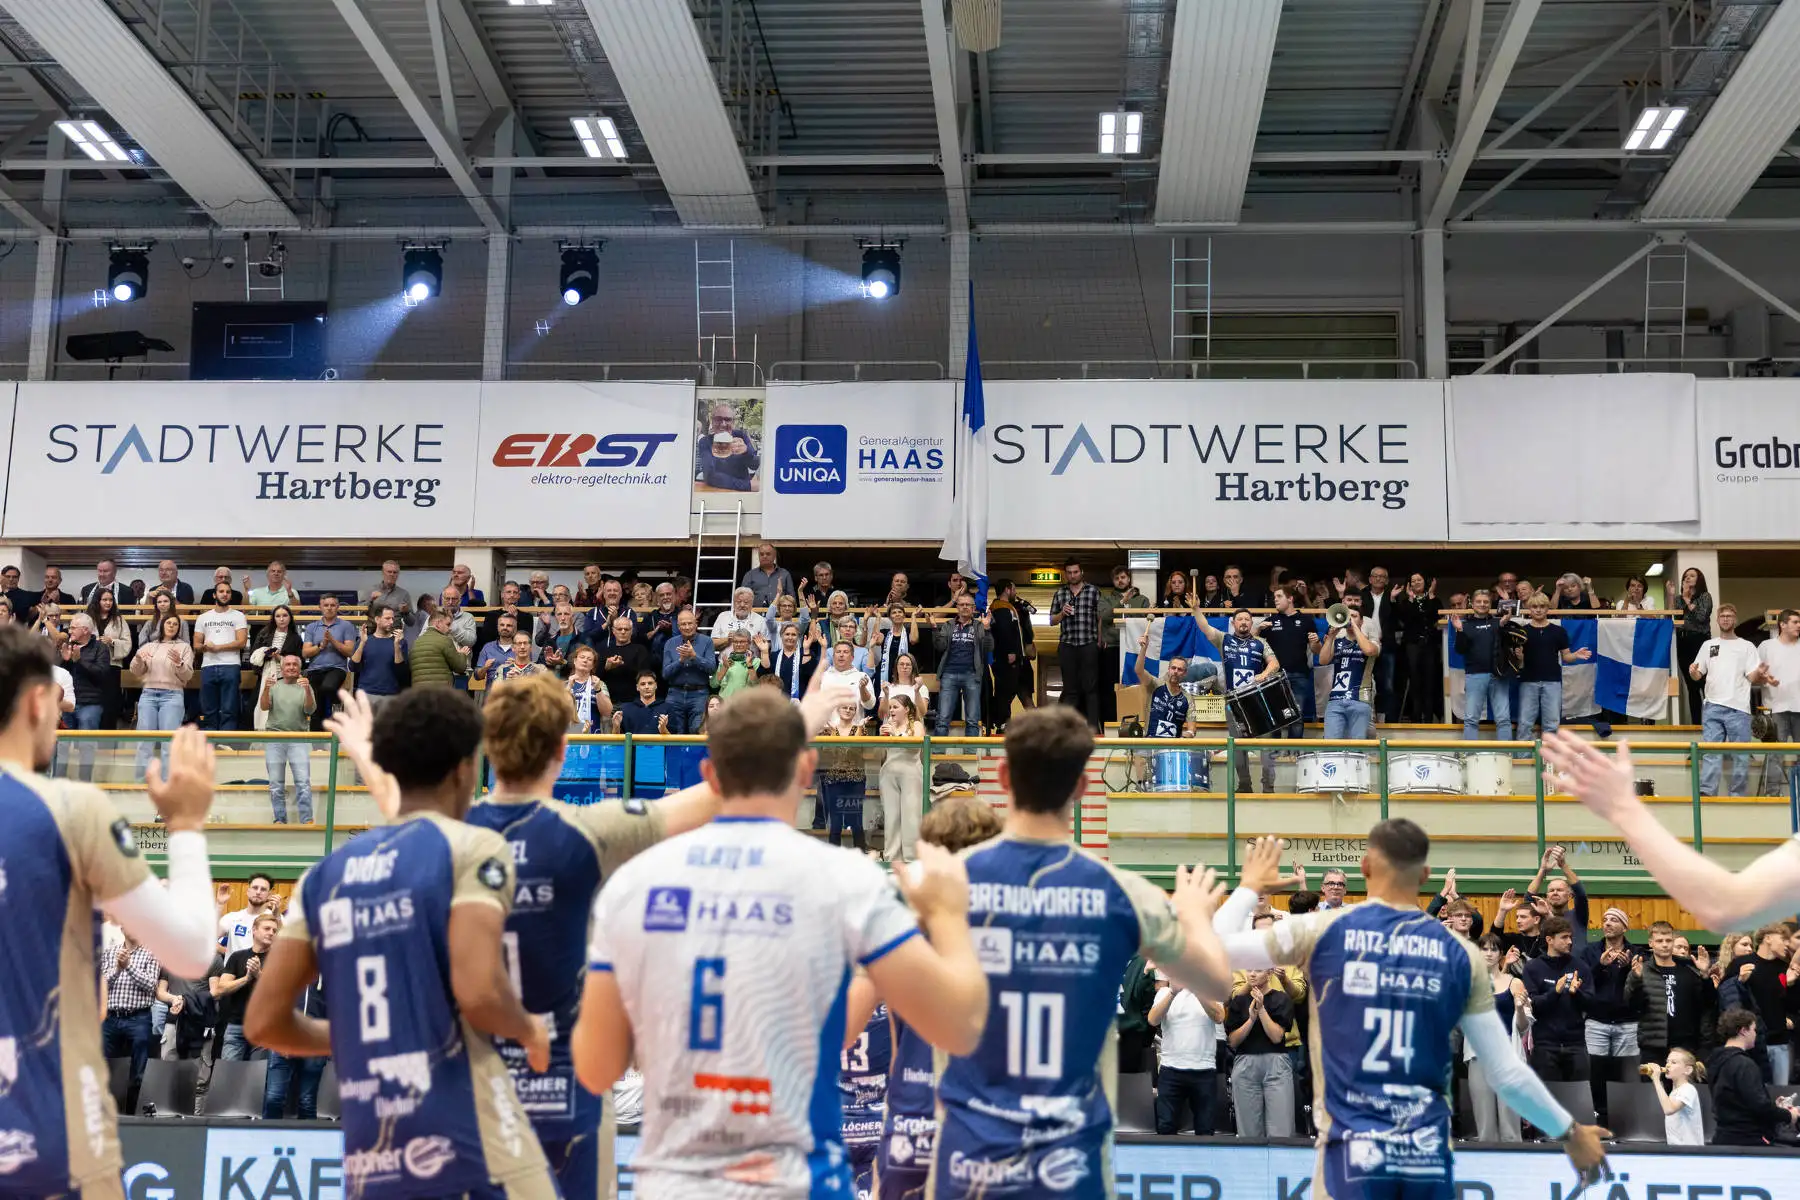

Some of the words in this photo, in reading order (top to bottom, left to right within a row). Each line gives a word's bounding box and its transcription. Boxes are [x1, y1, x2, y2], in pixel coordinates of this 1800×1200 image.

[46, 423, 444, 474] STADTWERKE
[859, 436, 944, 448] GeneralAgentur
[993, 423, 1409, 475] STADTWERKE
[858, 448, 944, 470] HAAS
[531, 472, 667, 487] elektro-regeltechnik.at
[779, 467, 841, 482] UNIQA
[1716, 473, 1759, 485] Gruppe
[256, 472, 441, 507] Hartberg
[1215, 472, 1409, 509] Hartberg
[135, 840, 168, 852] rtberg
[1312, 852, 1361, 862] Hartber
[355, 897, 414, 928] HAAS
[697, 901, 792, 926] HAAS
[1014, 941, 1100, 964] HAAS
[1380, 972, 1441, 993] HAAS
[356, 955, 390, 1043] 8
[688, 957, 726, 1051] 6
[1000, 991, 1064, 1079] 10
[1361, 1008, 1416, 1075] 24
